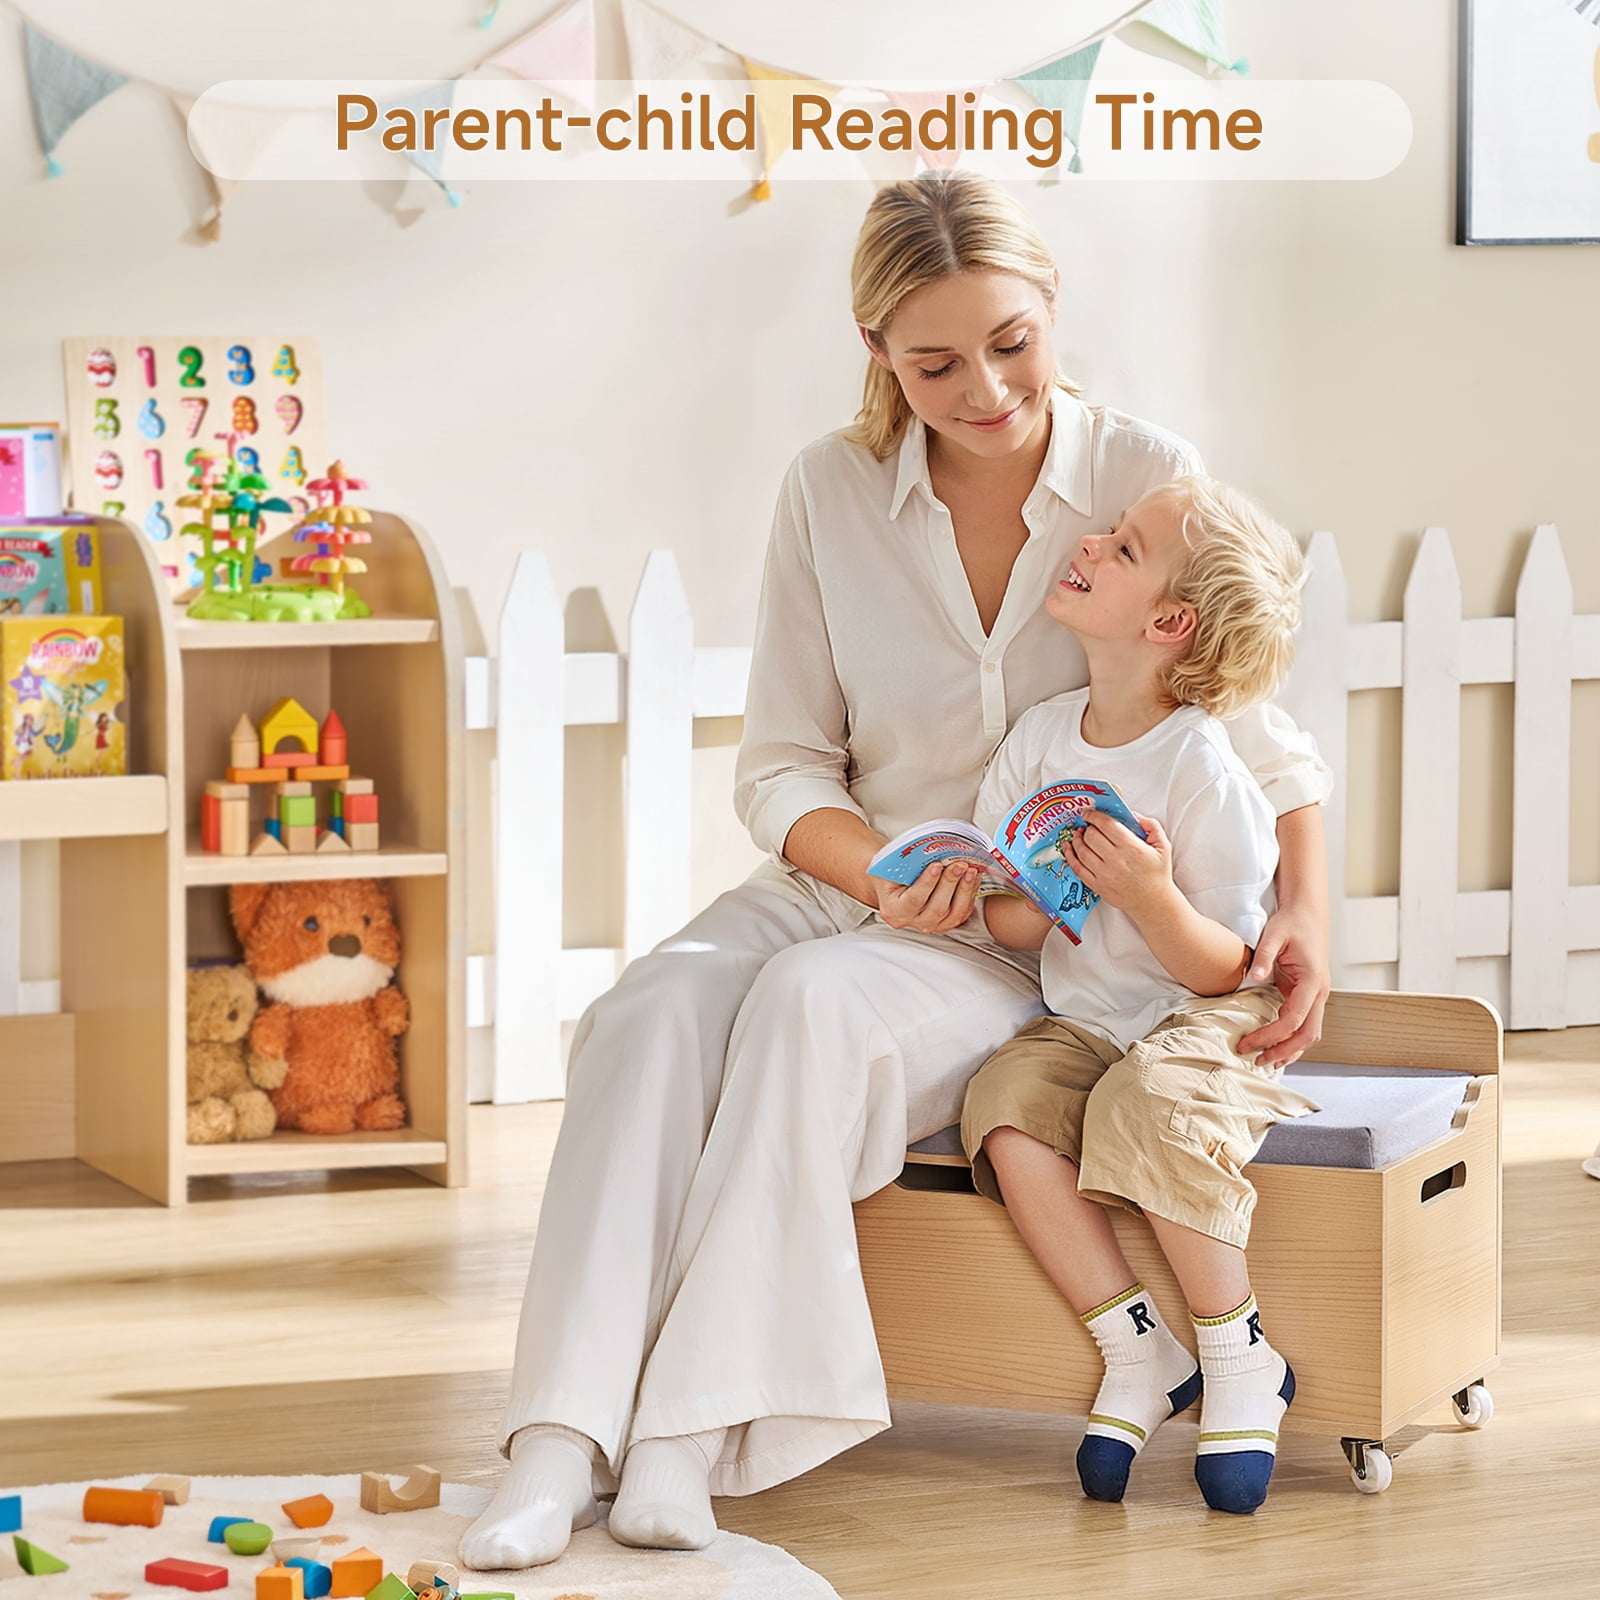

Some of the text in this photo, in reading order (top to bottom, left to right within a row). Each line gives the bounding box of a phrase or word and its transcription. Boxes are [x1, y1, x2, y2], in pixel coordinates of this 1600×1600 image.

[136, 346, 157, 389] 1
[177, 346, 206, 388] 2
[227, 345, 256, 387] 3
[271, 344, 301, 386] 4
[136, 397, 166, 440] 6
[180, 397, 209, 438] 7
[232, 395, 259, 436] 8
[275, 395, 304, 436] 9
[144, 449, 163, 490] 1
[279, 446, 307, 486] 4
[144, 501, 172, 542] 6
[31, 640, 98, 659] RAINBOW
[1013, 783, 1086, 824] EARLY READER
[1022, 796, 1091, 841] RAINBOW
[1126, 1301, 1157, 1337] R
[1246, 1310, 1264, 1347] R
